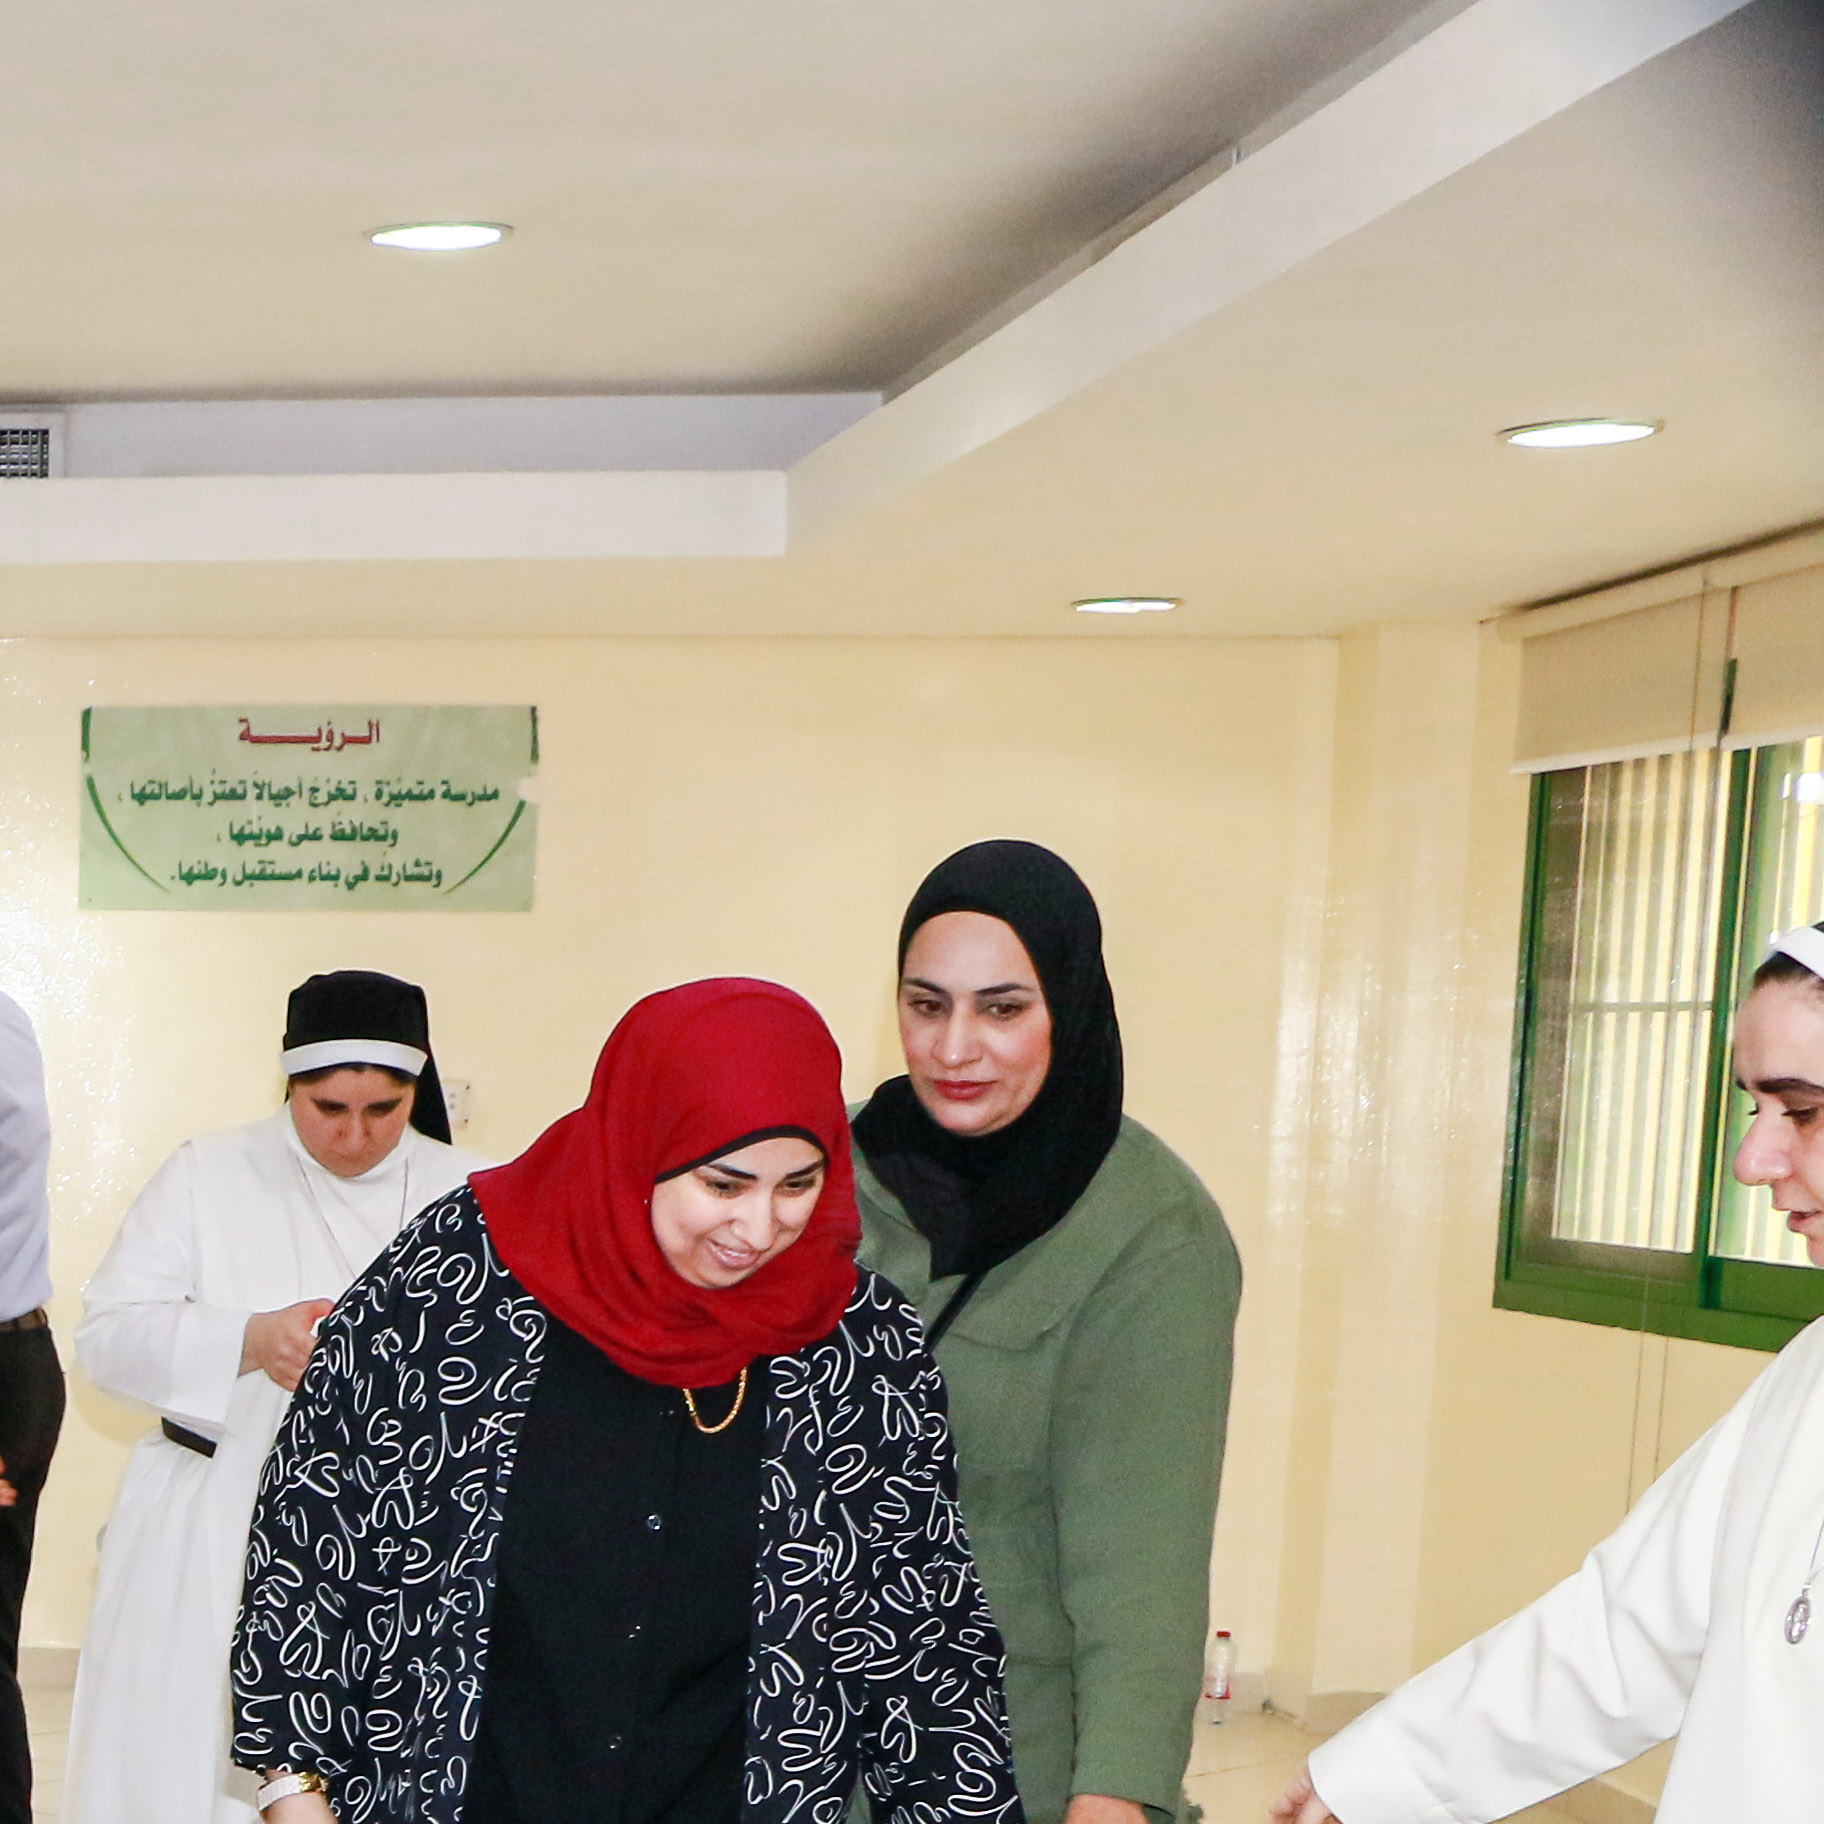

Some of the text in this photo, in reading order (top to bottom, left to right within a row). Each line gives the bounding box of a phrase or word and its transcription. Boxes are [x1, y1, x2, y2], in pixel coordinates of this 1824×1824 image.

[239, 717, 381, 752] الرؤية
[441, 780, 499, 806] مدرسة
[233, 859, 303, 887] مستقبل
[308, 860, 341, 888] بناء
[345, 860, 370, 891] في
